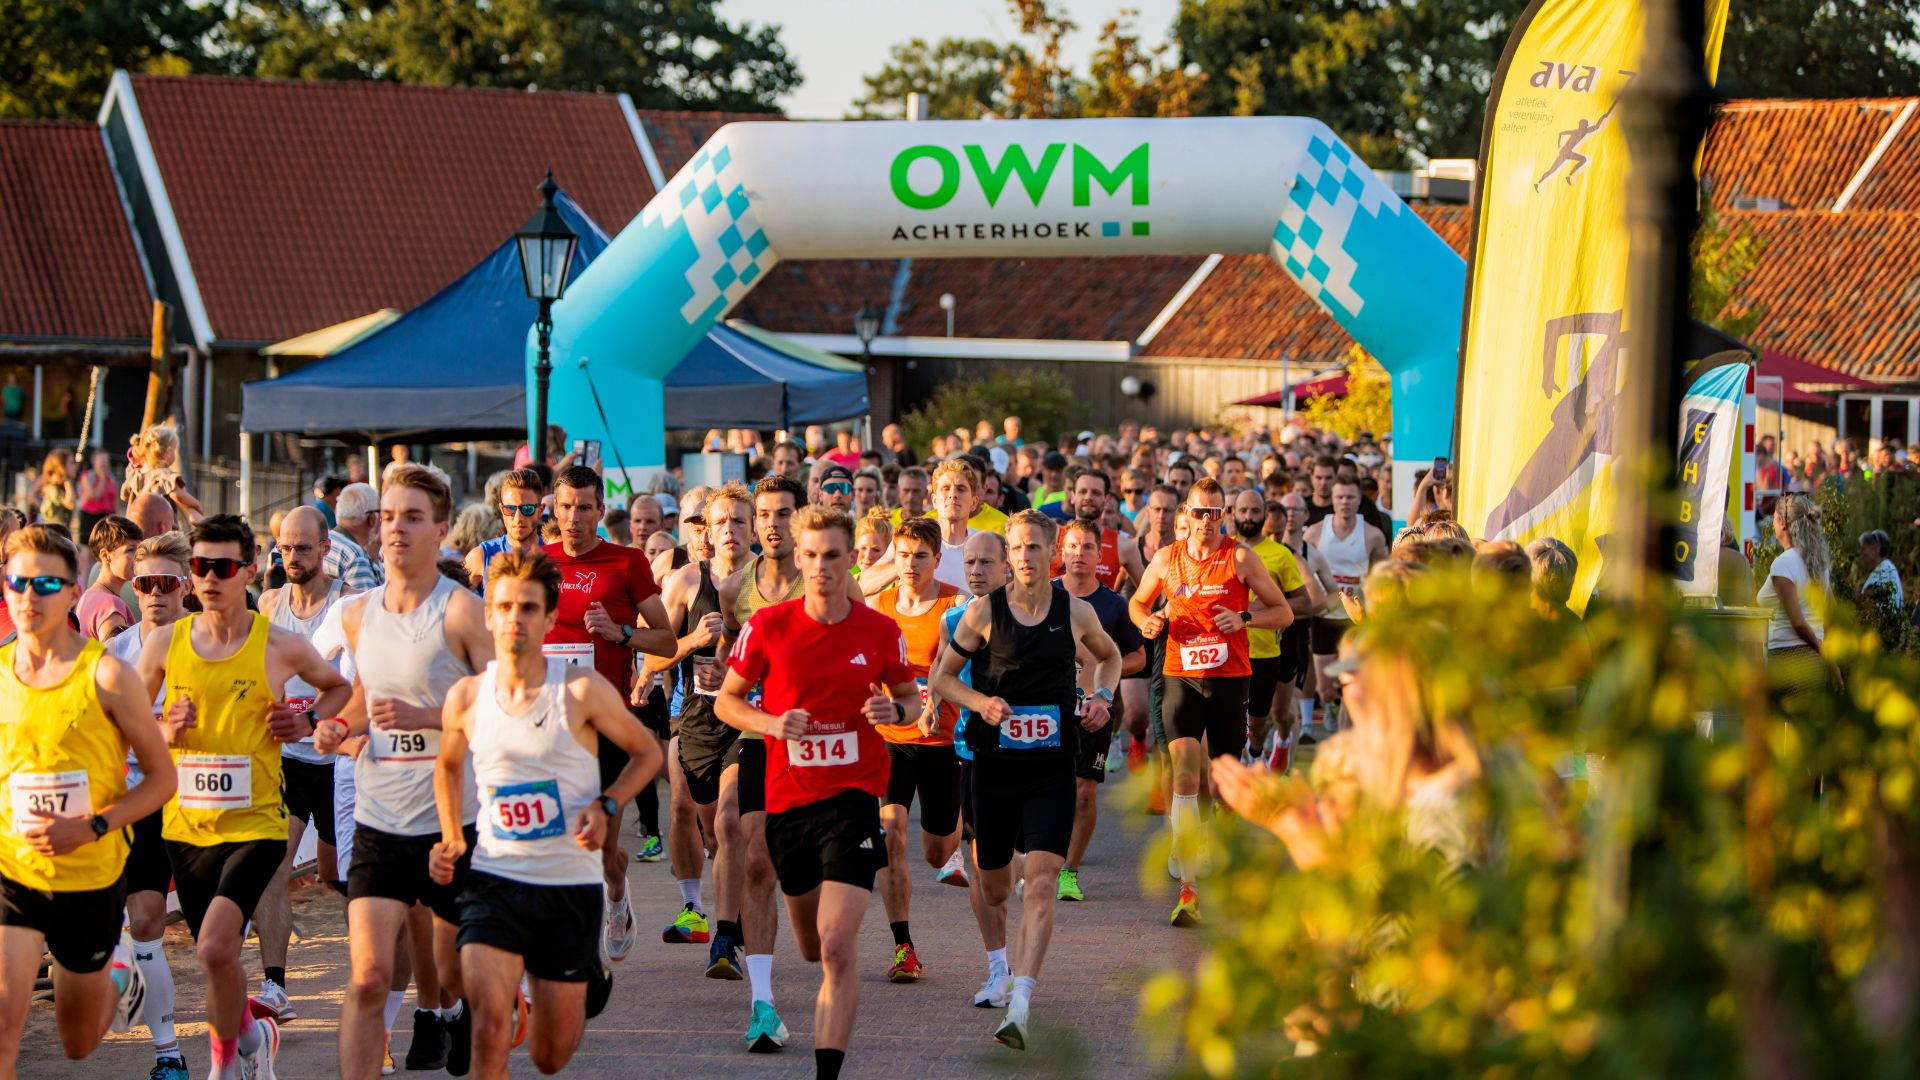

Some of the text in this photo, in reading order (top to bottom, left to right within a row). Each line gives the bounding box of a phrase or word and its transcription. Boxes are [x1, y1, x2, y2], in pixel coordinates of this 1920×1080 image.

[1530, 61, 1597, 92] ava
[1515, 96, 1548, 108] atletiek
[1509, 110, 1554, 124] vereniging
[1501, 121, 1527, 133] aalten
[890, 142, 1149, 210] OWM
[892, 221, 1090, 241] ACHTERHOEK
[1189, 648, 1220, 666] 262
[821, 722, 846, 731] RESULT
[1009, 719, 1050, 738] 515
[389, 733, 426, 752] 759
[800, 739, 846, 761] 314
[195, 773, 232, 792] 660
[28, 792, 69, 813] 357
[499, 799, 546, 828] 591
